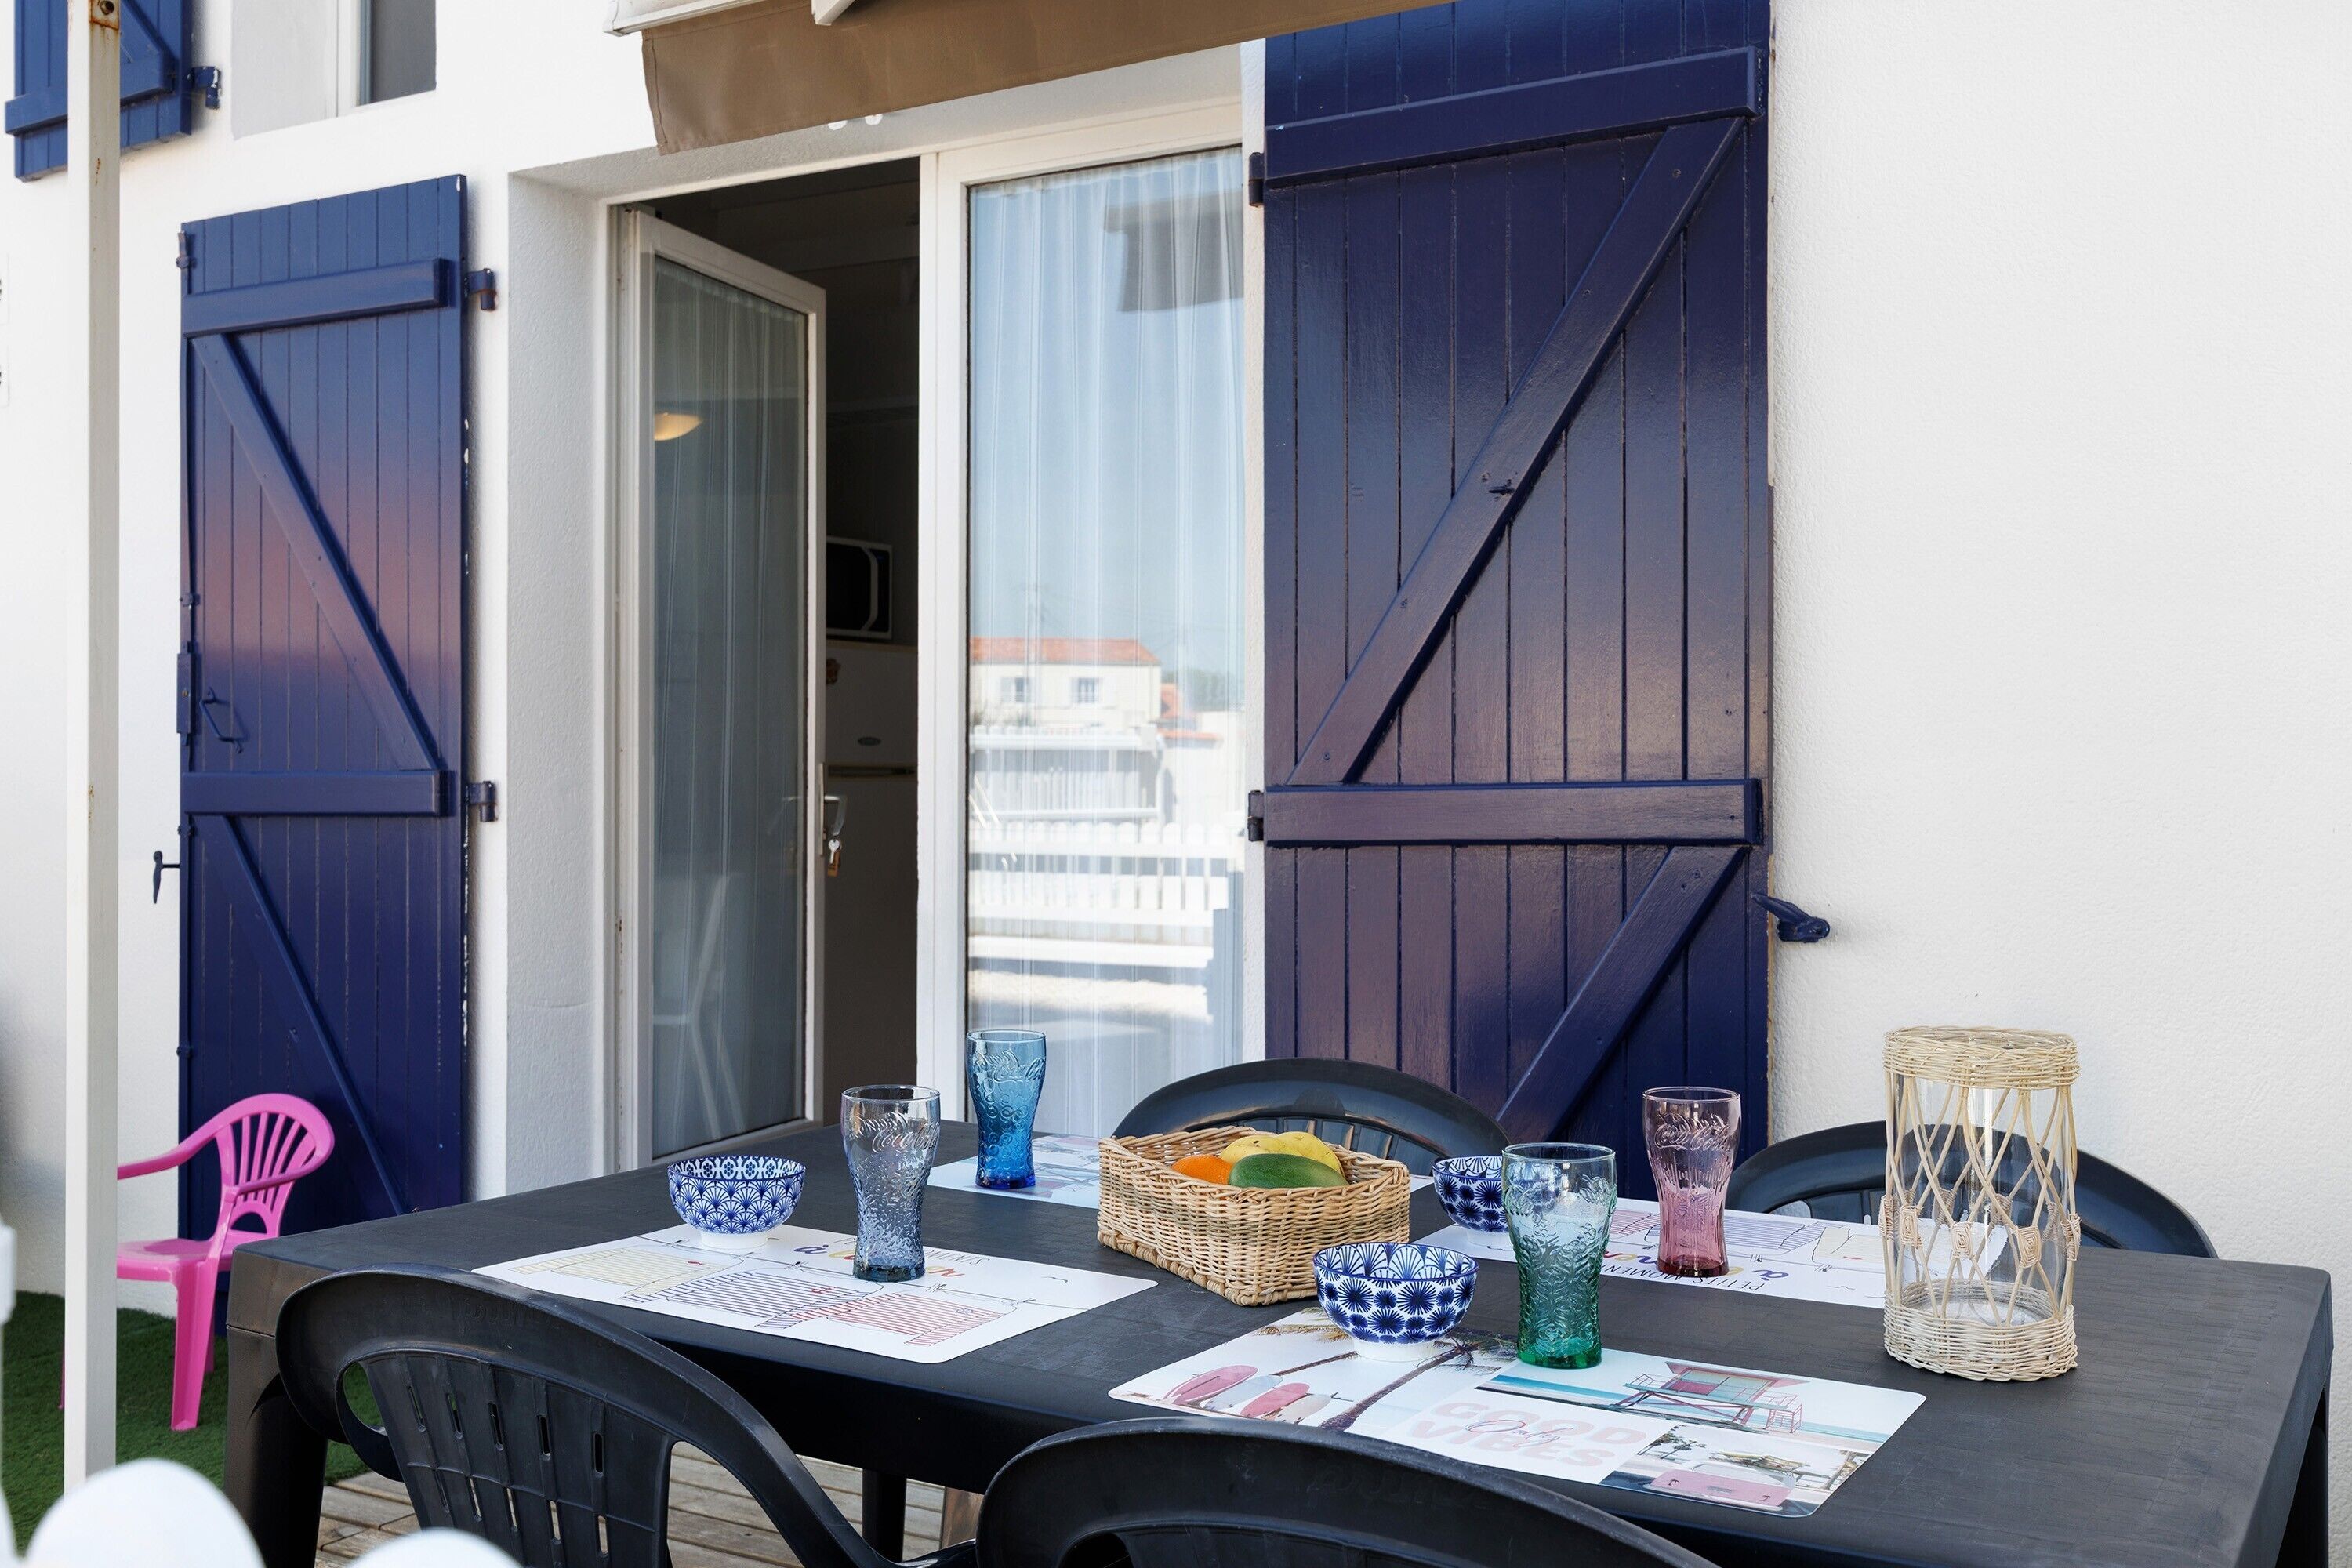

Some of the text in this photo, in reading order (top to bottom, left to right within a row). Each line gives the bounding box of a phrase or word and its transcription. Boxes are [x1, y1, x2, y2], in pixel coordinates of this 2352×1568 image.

[1601, 1264, 1684, 1282] MOMEN
[1693, 1276, 1766, 1290] PETITS
[1429, 1402, 1647, 1445] GOOD
[1465, 1419, 1574, 1448] Only
[1408, 1419, 1616, 1467] VIBES
